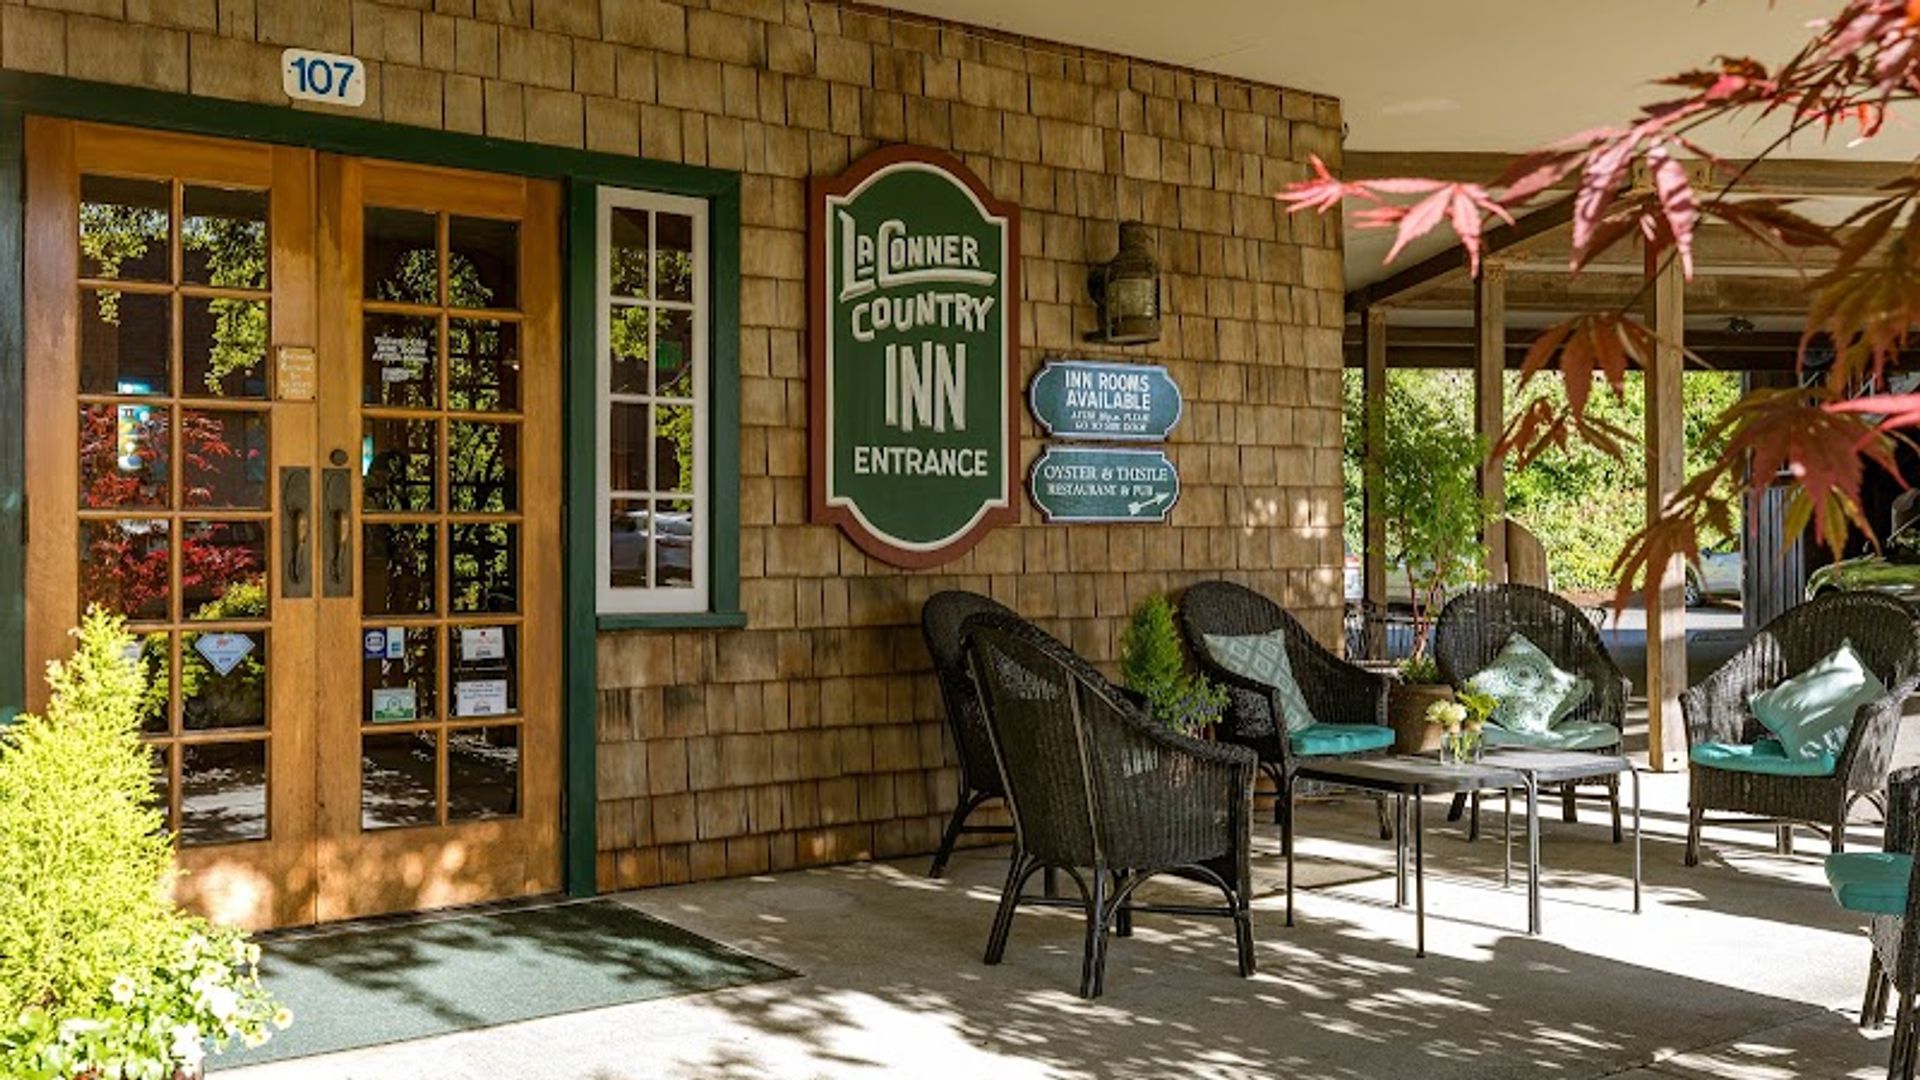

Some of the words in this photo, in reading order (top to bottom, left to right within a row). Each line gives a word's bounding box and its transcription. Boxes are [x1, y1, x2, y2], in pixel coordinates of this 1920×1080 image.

[291, 57, 355, 97] 107
[852, 291, 995, 341] COUNTRY
[885, 340, 967, 433] INN
[1065, 370, 1093, 389] INN
[1099, 372, 1149, 392] ROOMS
[1066, 389, 1151, 411] AVAILABLE
[854, 446, 988, 477] ENTRANCE
[1044, 465, 1098, 481] OYSTER
[1101, 467, 1113, 481] &
[1116, 466, 1168, 481] THISTLE
[1046, 483, 1117, 496] RESTAURANT
[1120, 485, 1129, 497] &
[1132, 485, 1154, 496] PUB
